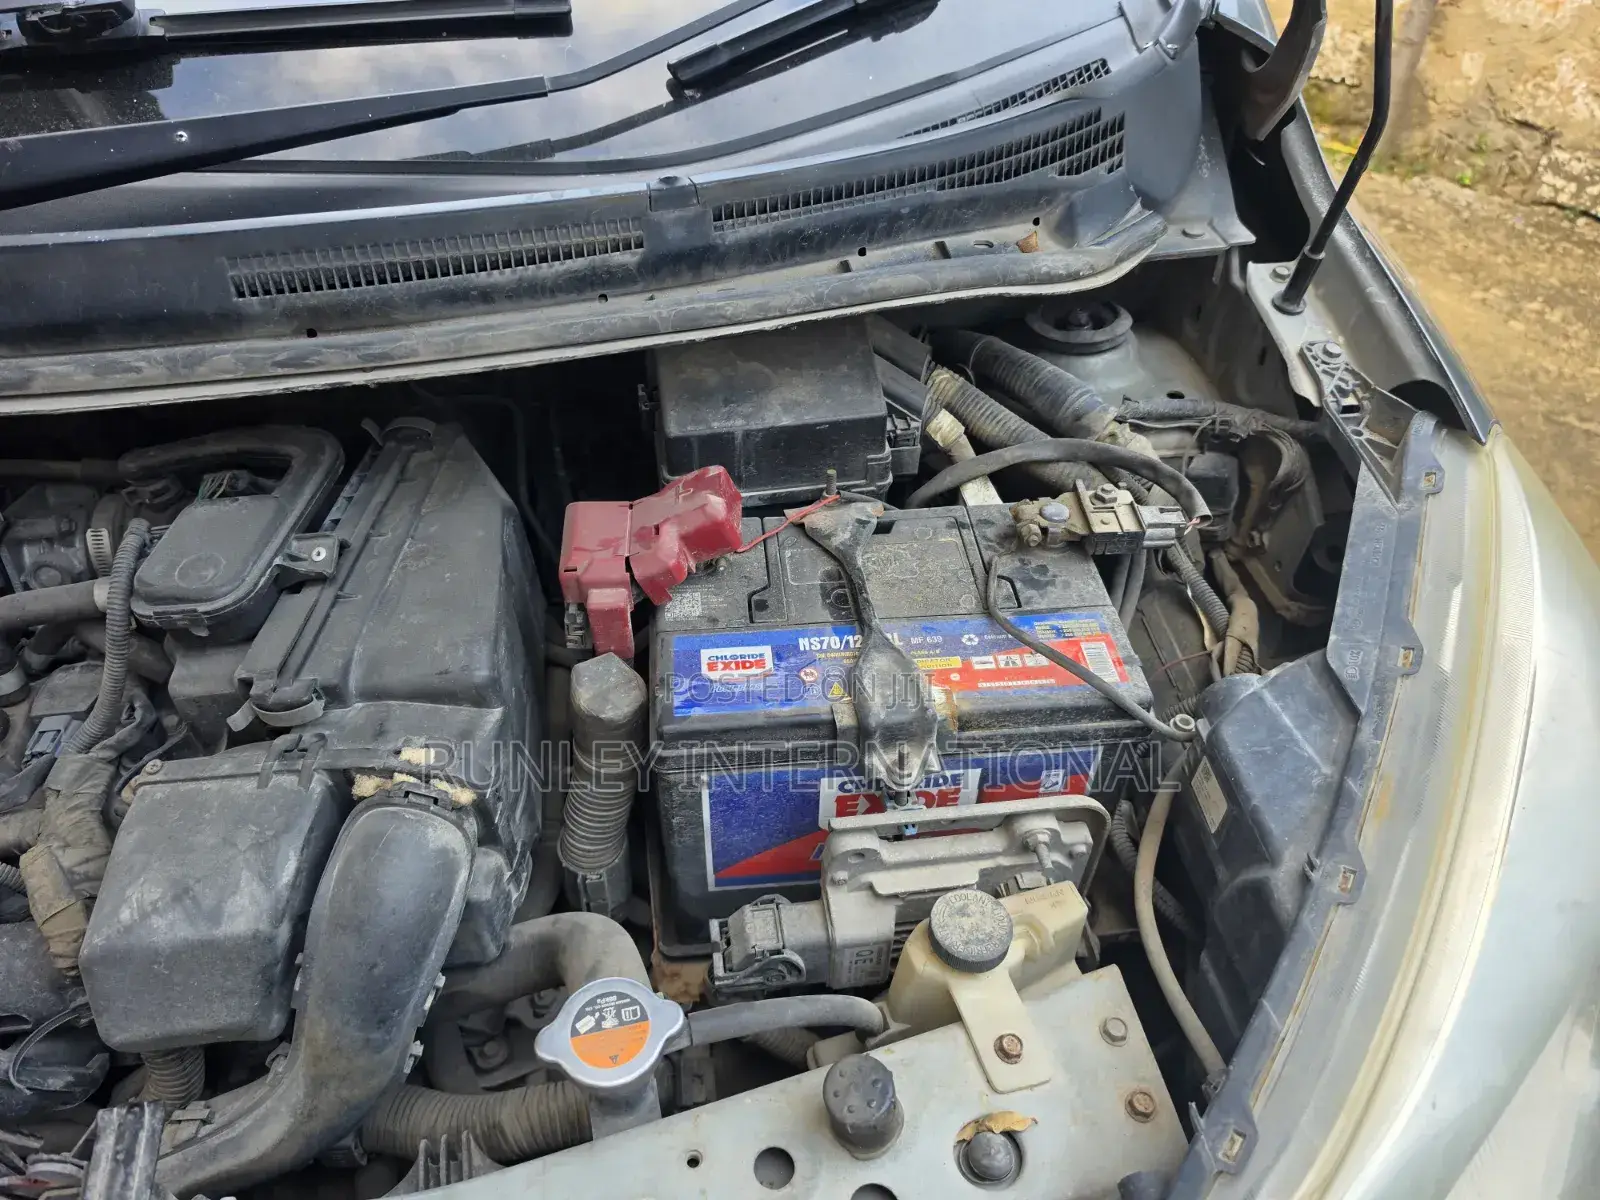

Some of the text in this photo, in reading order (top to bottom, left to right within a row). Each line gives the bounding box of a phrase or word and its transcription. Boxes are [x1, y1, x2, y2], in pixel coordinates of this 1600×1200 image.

[708, 653, 766, 661] CHLORIDE
[707, 659, 767, 672] EXIDE
[835, 788, 961, 818] EXDE
